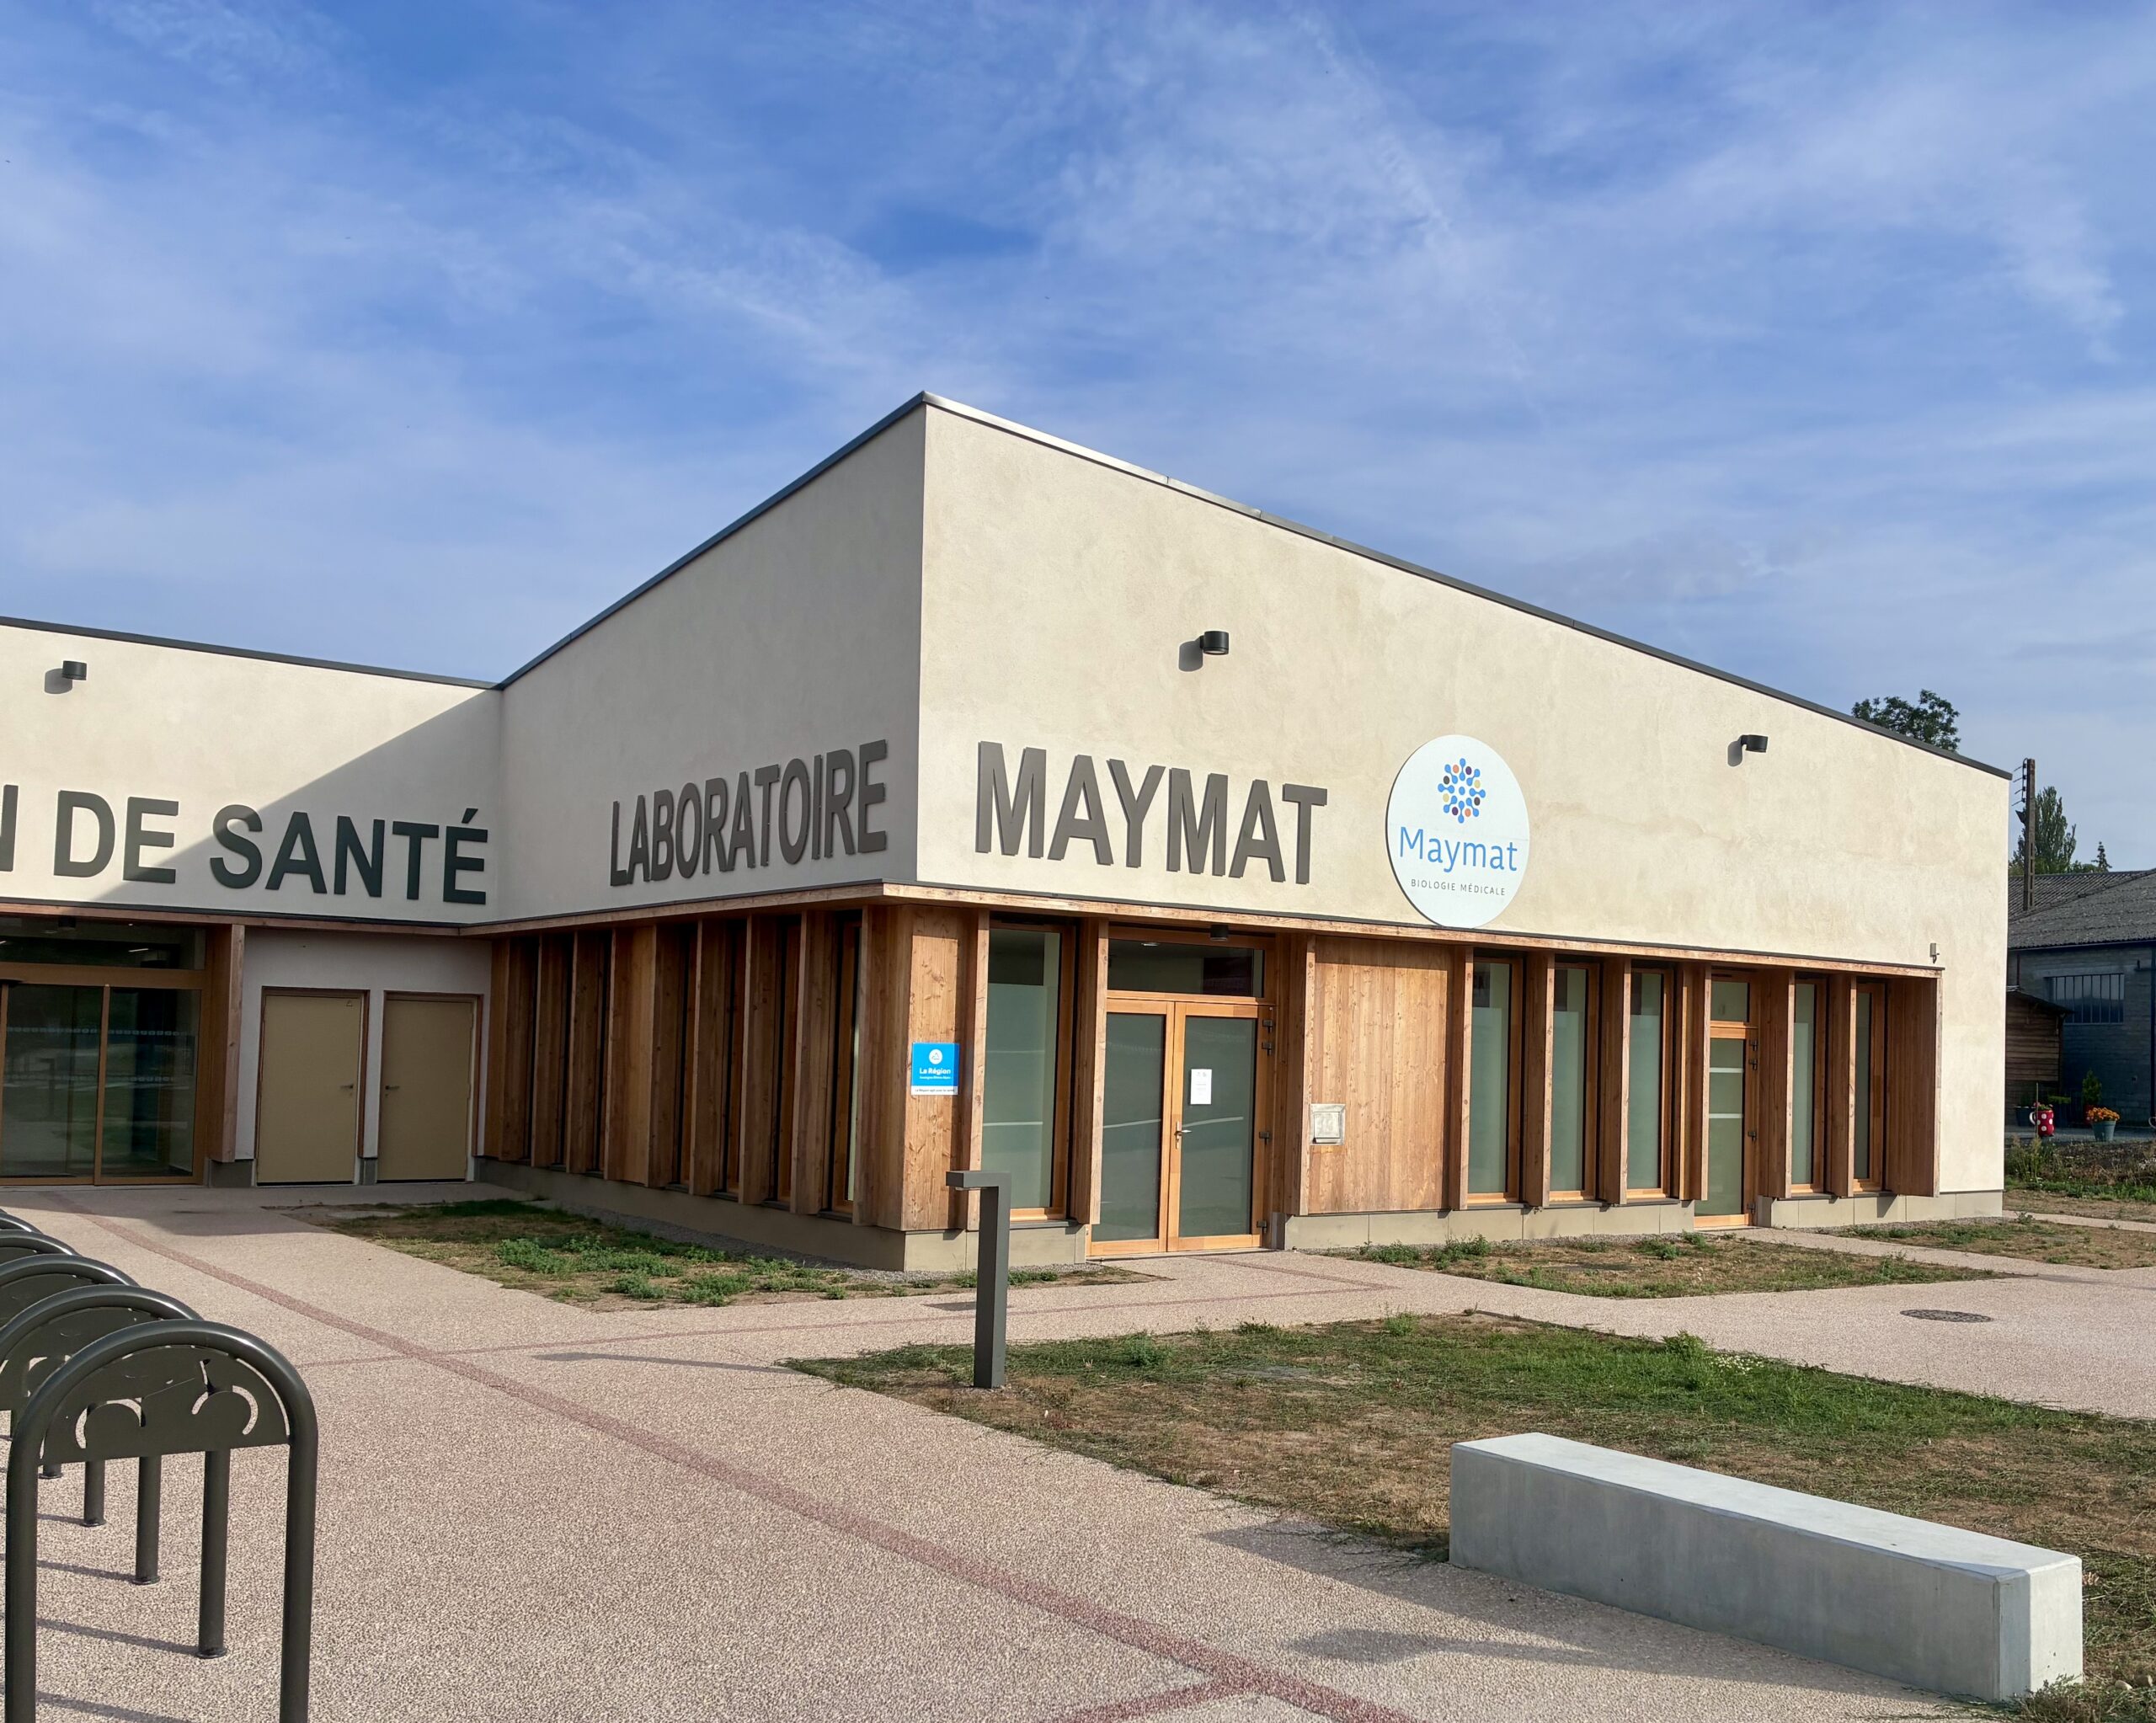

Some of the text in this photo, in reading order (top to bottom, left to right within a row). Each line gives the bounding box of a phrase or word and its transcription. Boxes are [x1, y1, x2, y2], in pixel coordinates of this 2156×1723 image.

[54, 790, 179, 883] DE
[210, 808, 488, 905] SANTÉ
[610, 739, 888, 887] LABORATOIRE
[975, 740, 1328, 884] MAYMAT
[1400, 826, 1518, 873] Maymat
[1411, 878, 1506, 896] BIOLOGIE MÉDICALE
[928, 1067, 952, 1075] Région
